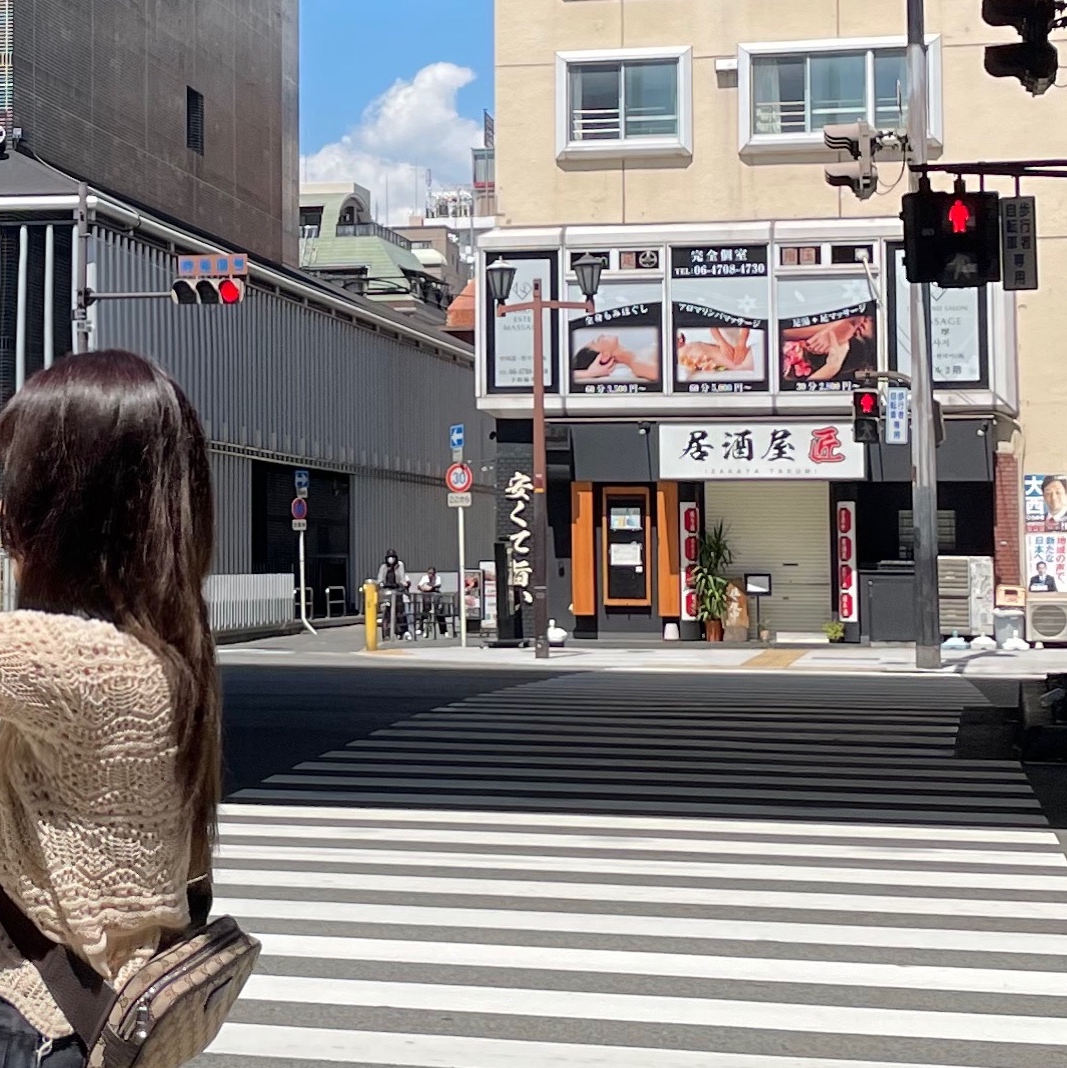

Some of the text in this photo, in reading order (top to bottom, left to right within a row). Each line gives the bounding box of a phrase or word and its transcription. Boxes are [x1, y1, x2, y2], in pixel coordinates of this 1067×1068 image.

[691, 248, 748, 262] 完全個室
[933, 317, 962, 325] SAGE
[679, 426, 846, 464] 居酒屋匠
[452, 471, 467, 485] 30
[1034, 536, 1044, 560] 日本へ
[1046, 536, 1055, 562] 新たな
